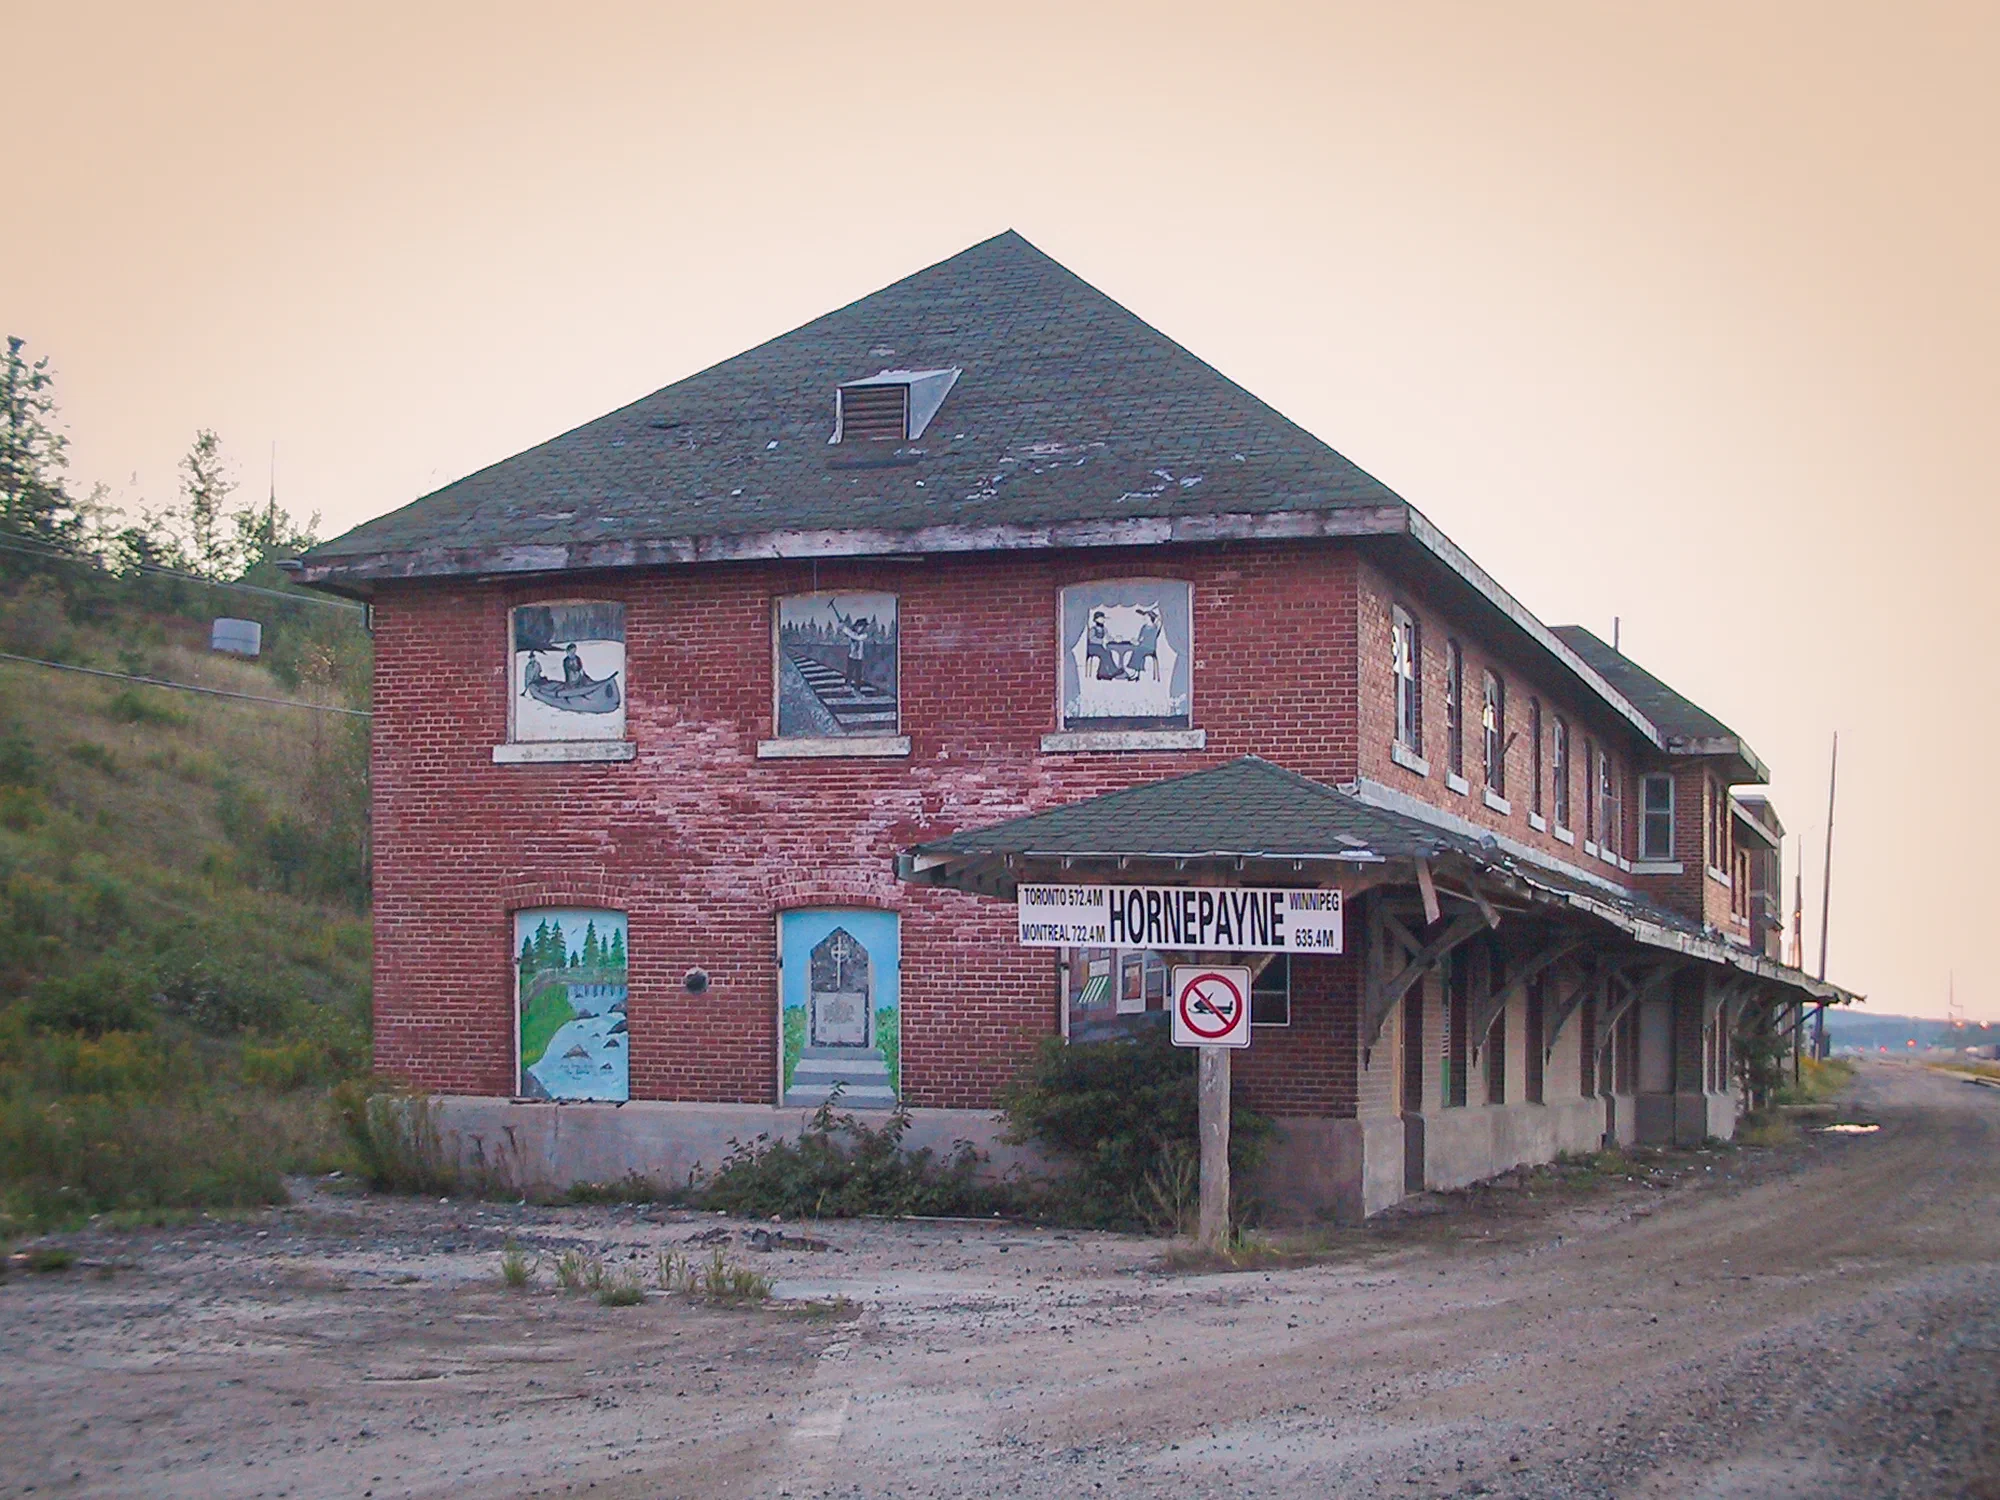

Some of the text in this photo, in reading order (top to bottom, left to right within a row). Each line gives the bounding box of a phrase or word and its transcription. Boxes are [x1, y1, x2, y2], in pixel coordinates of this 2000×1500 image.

[1024, 888, 1066, 905] TORONTO
[1289, 892, 1339, 911] WINNIPEG
[1109, 889, 1285, 946] HORNEPAYNE
[1022, 924, 1070, 941] MONTREAL
